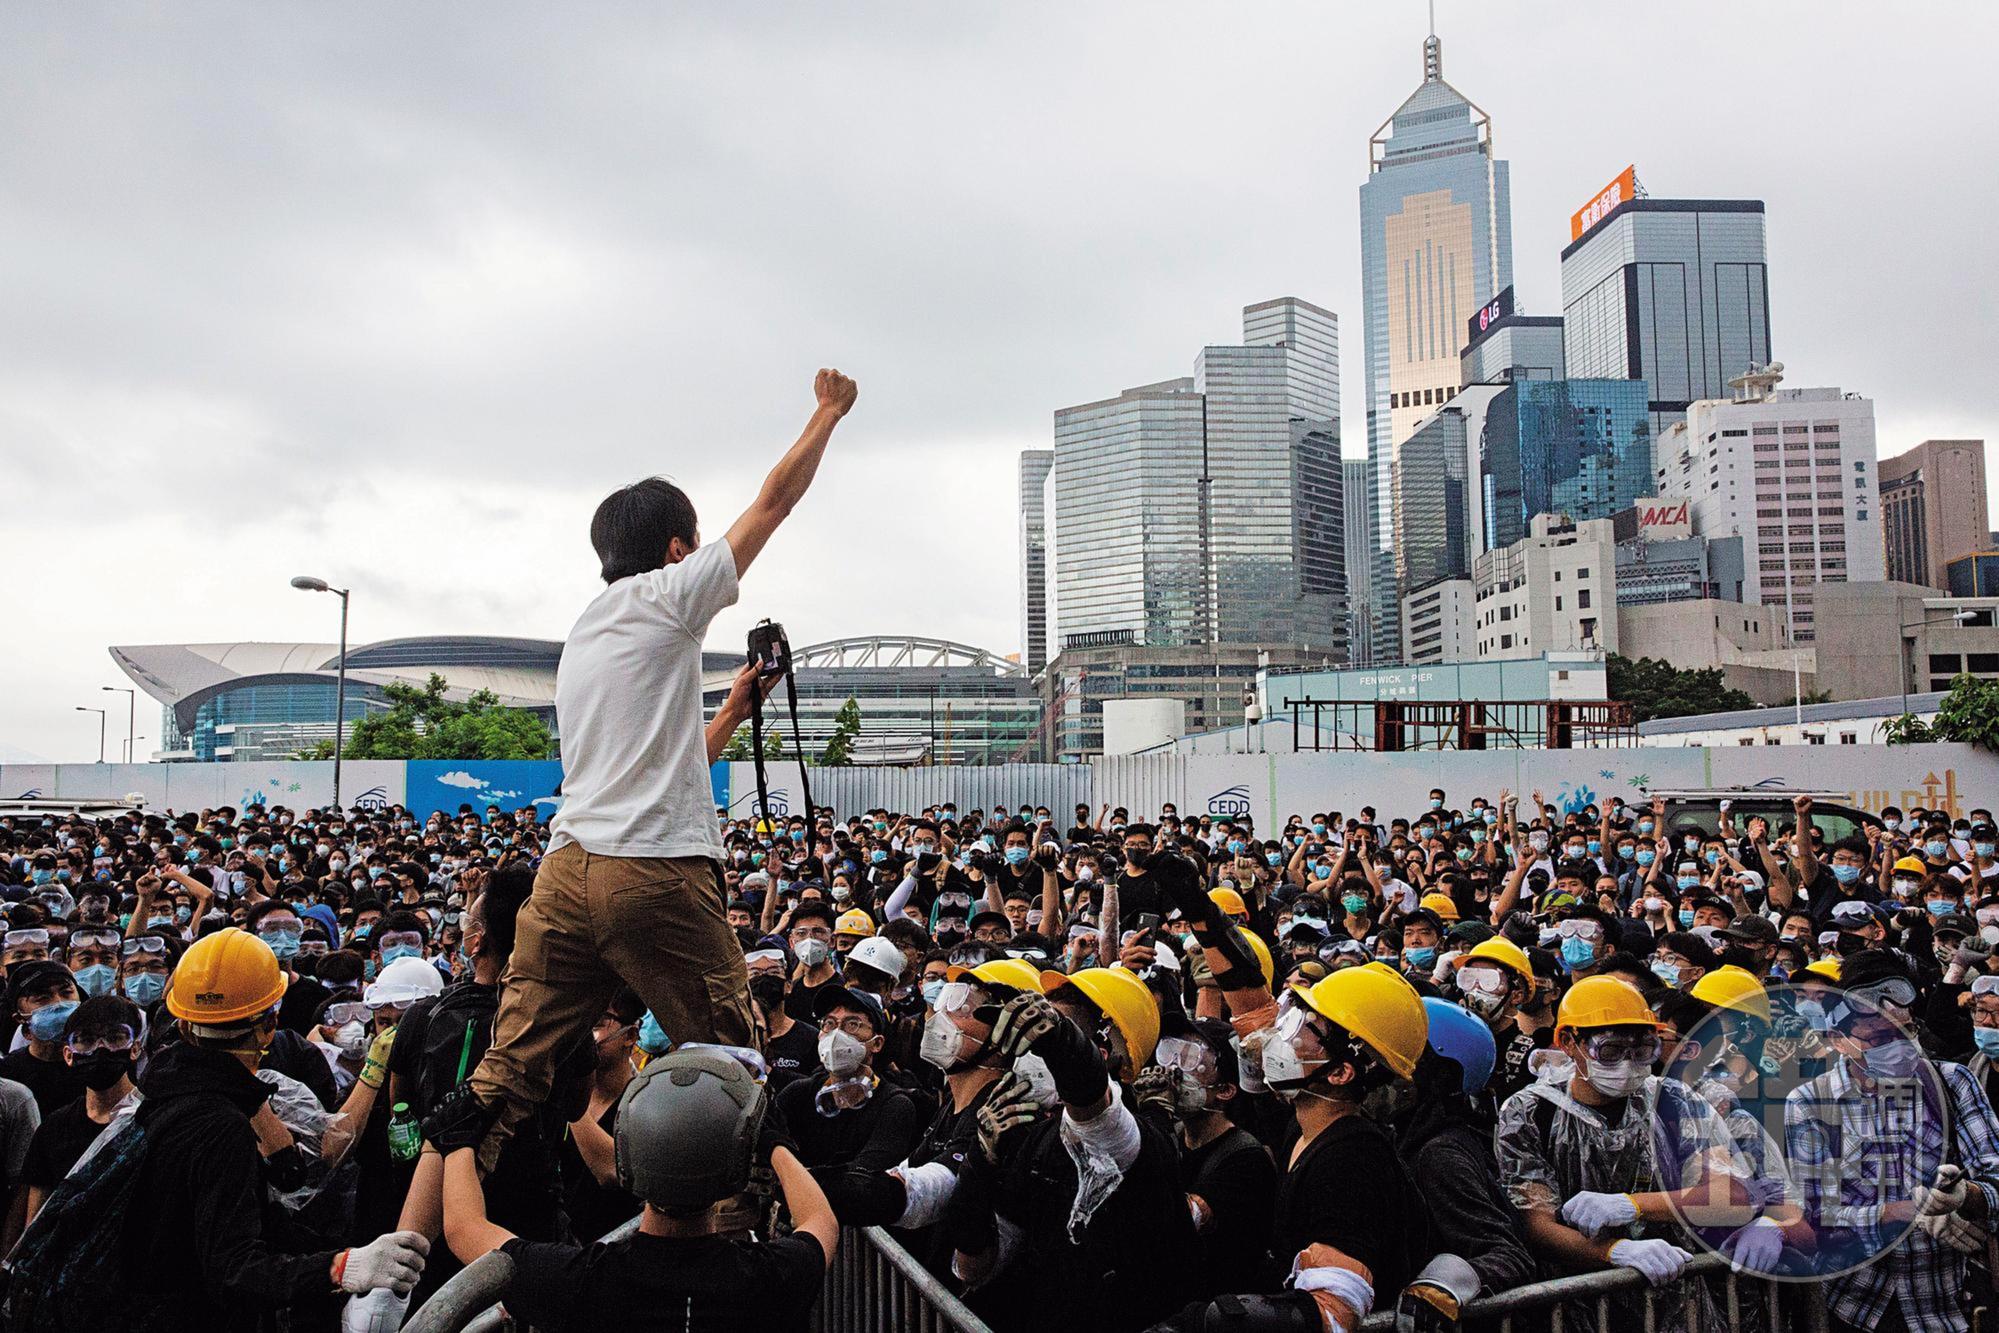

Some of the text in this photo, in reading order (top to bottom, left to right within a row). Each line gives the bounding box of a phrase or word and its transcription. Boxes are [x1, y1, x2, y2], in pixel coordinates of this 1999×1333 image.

[1488, 301, 1500, 323] LG
[1360, 673, 1433, 685] FENWICK PIER
[752, 803, 788, 817] CDD
[1208, 800, 1250, 814] CEDD
